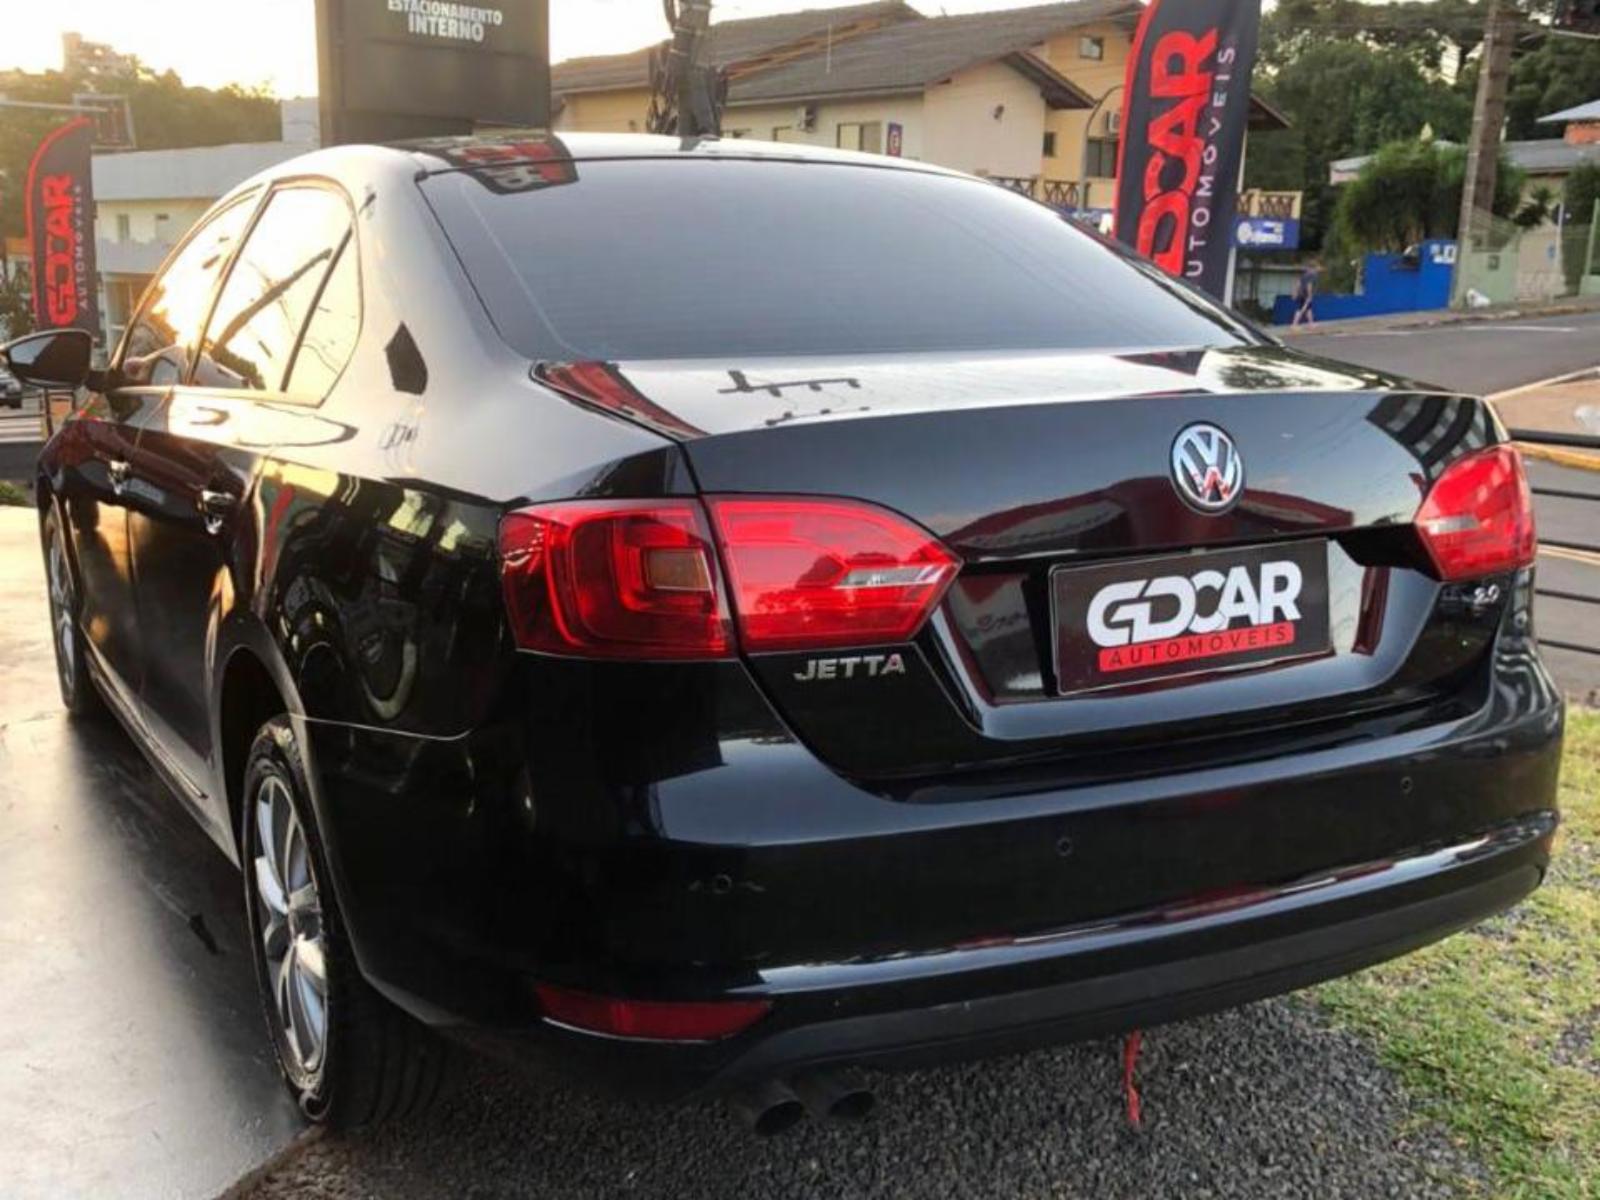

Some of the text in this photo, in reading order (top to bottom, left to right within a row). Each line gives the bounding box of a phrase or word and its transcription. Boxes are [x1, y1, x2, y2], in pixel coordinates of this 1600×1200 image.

[388, 0, 502, 25] ESTACIONAMENTO
[408, 12, 484, 42] INTERNO
[1136, 27, 1219, 277] DCAR
[42, 172, 78, 326] GDCAR
[1086, 560, 1302, 647] GDCAR
[793, 654, 905, 680] JETTA
